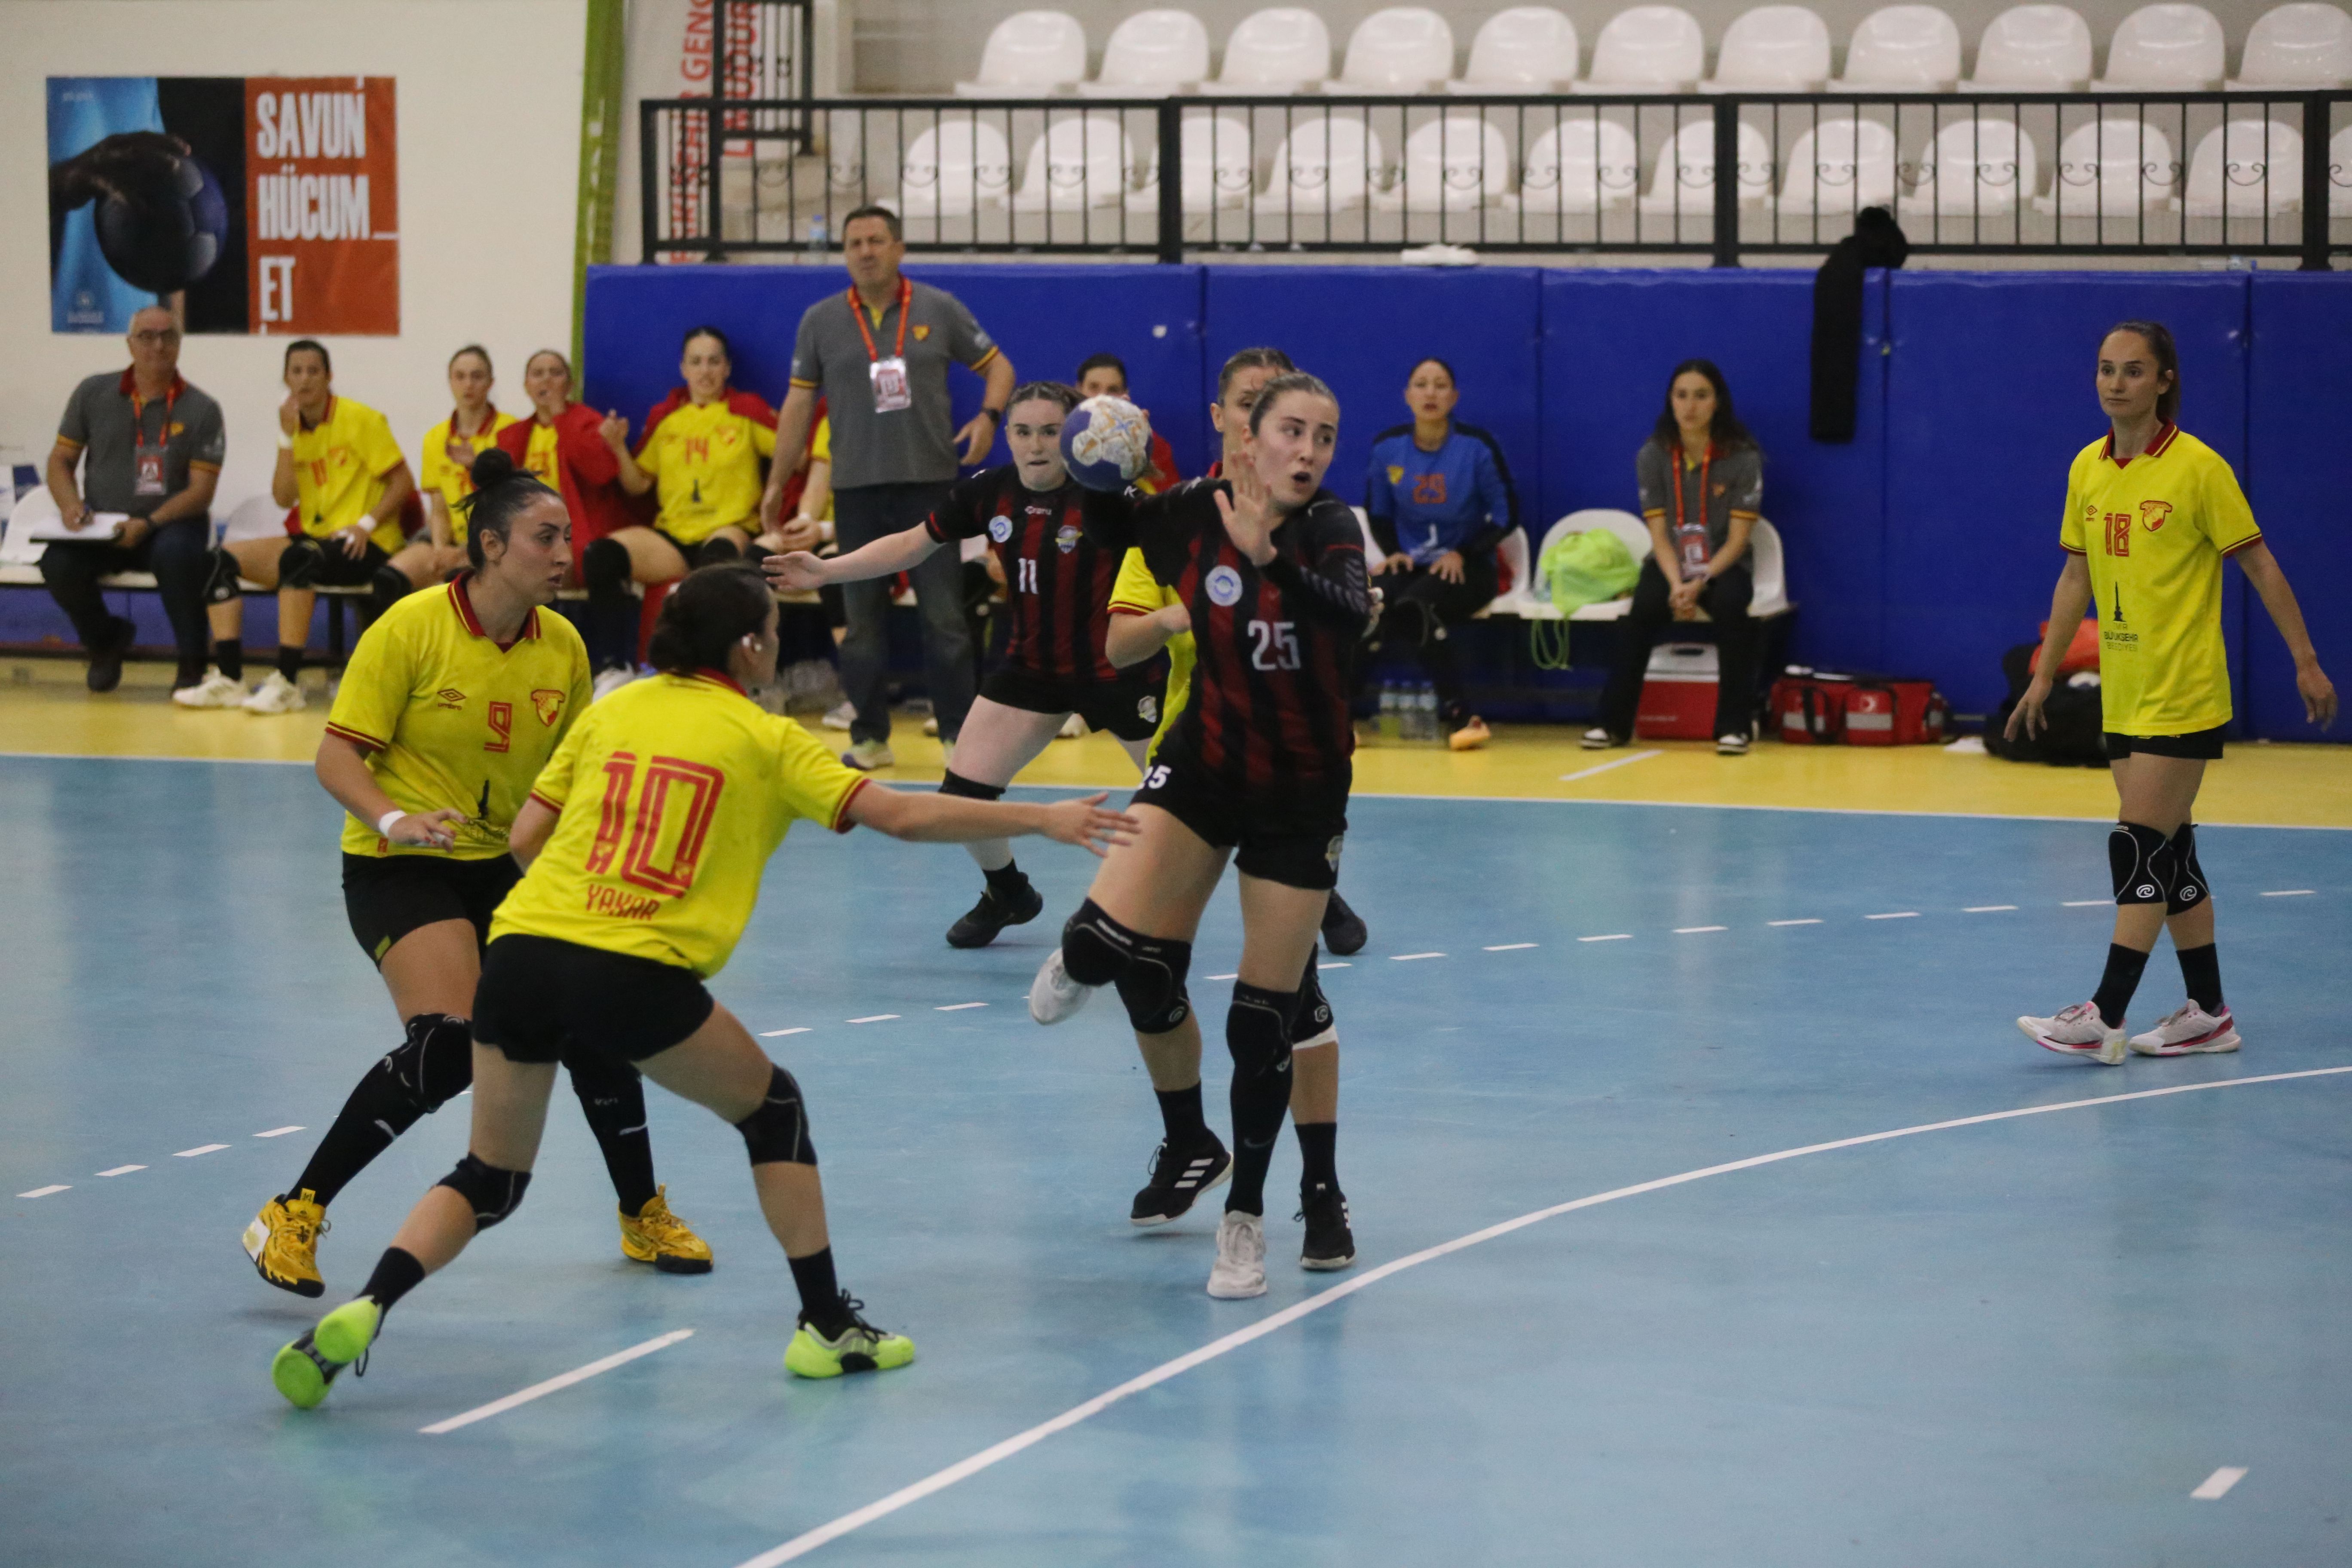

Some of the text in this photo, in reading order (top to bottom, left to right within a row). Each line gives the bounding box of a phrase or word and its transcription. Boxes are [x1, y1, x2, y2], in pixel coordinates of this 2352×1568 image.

[257, 92, 366, 158] SAVUN
[258, 165, 370, 239] HÜCUM
[260, 256, 296, 322] ET
[686, 438, 709, 464] 14
[2104, 512, 2132, 557] 18
[1018, 558, 1038, 594] 11
[1248, 620, 1300, 671] 25
[484, 701, 512, 753] 9
[585, 751, 725, 898] 10
